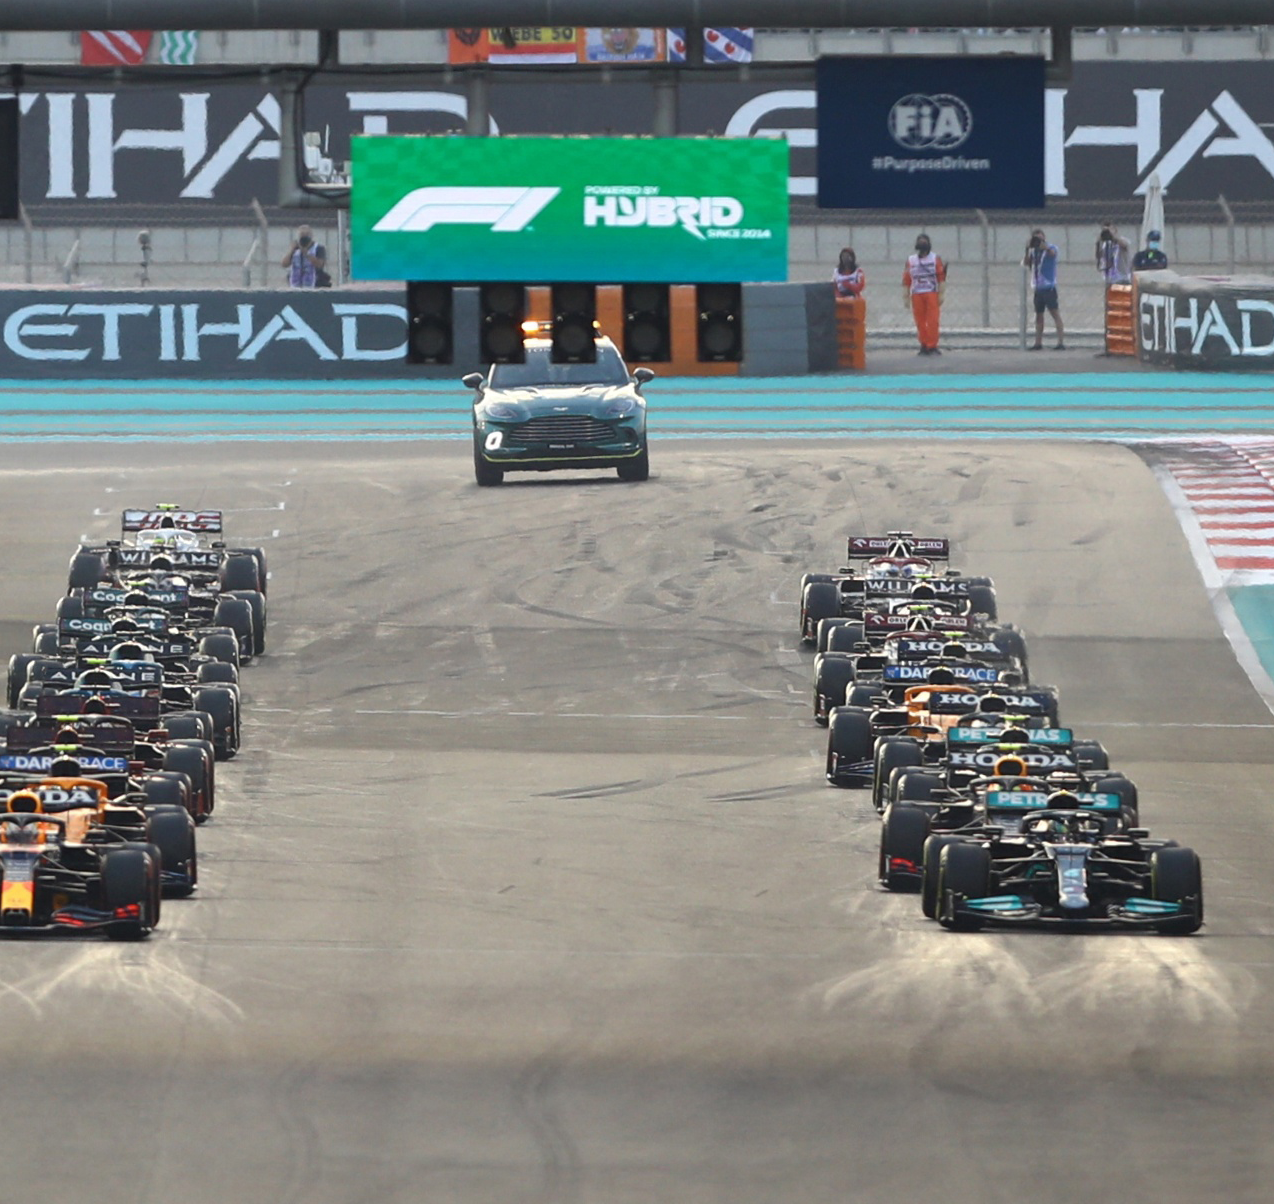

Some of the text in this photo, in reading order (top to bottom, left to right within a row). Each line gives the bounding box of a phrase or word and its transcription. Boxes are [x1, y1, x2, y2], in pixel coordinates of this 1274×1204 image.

[872, 156, 990, 173] #PurposeDriven
[584, 186, 659, 194] POWERED BY
[371, 186, 562, 232] F1
[583, 196, 745, 239] HYBRID
[707, 229, 740, 238] SINCE
[4, 303, 408, 361] ETIHAD
[908, 641, 1001, 653] HODA
[939, 693, 1041, 707] HODA
[950, 752, 1075, 767] HODA
